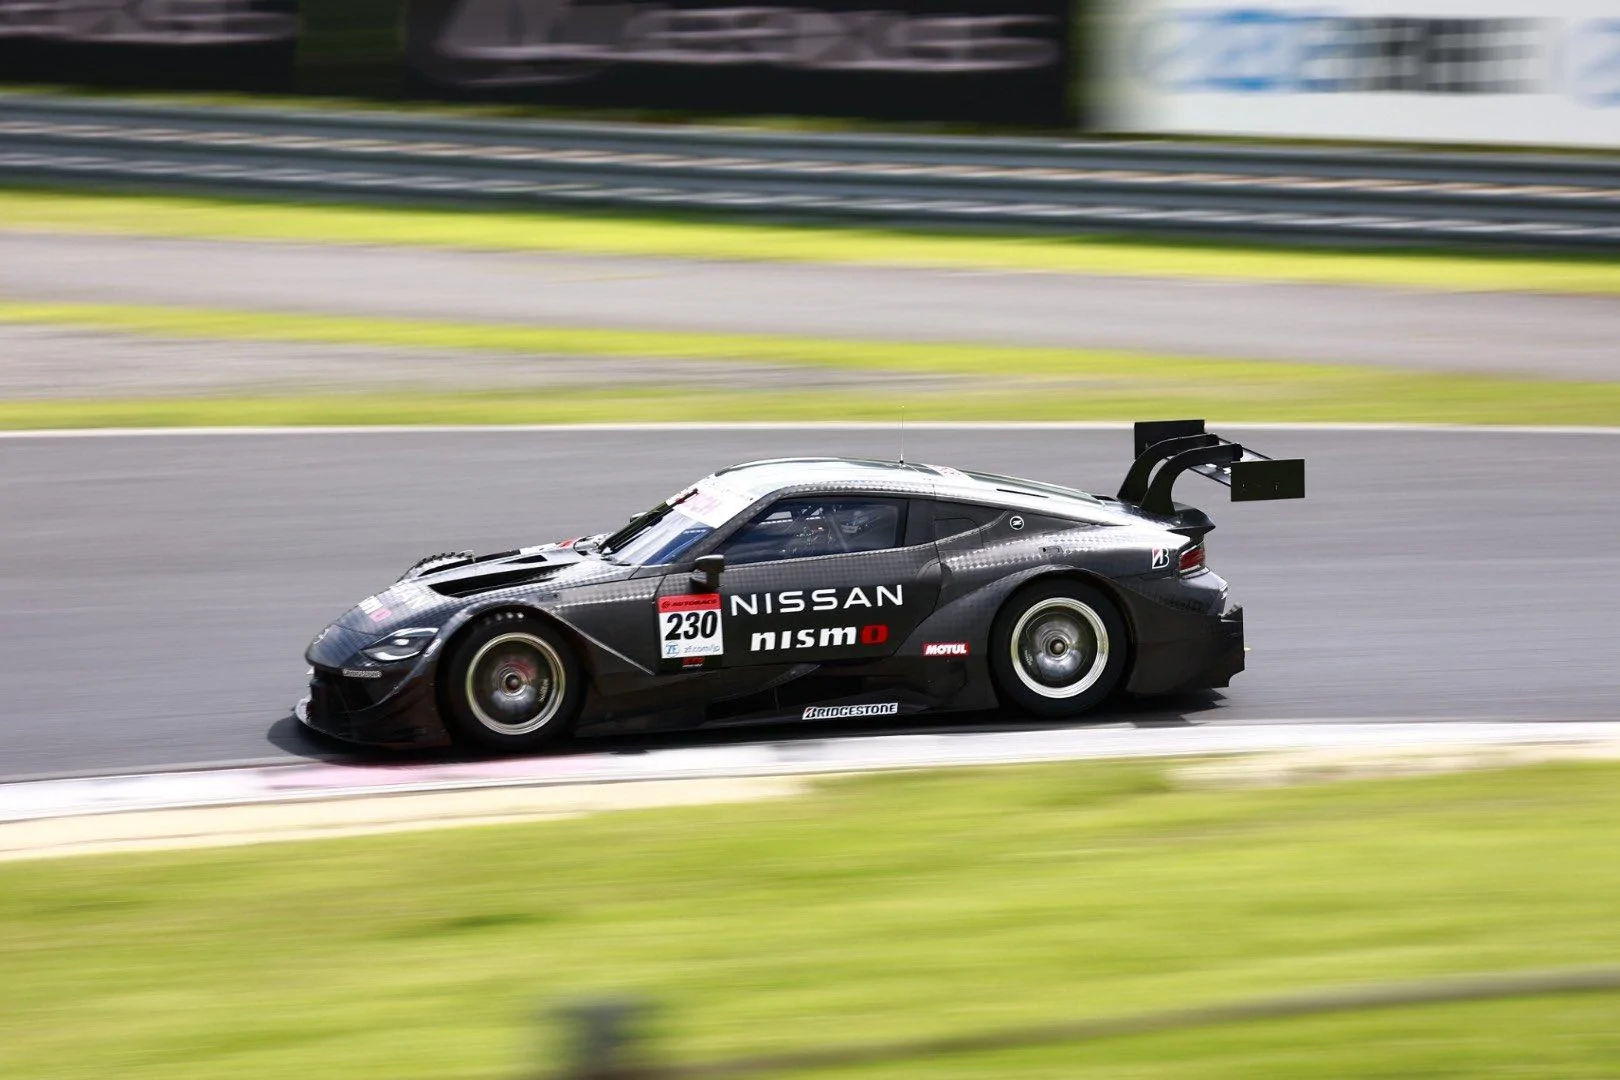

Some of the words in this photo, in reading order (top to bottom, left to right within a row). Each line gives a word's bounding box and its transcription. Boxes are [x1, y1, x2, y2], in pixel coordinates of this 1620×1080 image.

[730, 584, 903, 616] NISSAN
[665, 610, 718, 641] 230
[750, 624, 889, 651] nismo
[925, 643, 967, 656] MOTUL
[802, 703, 898, 720] BRIDGESTONE
